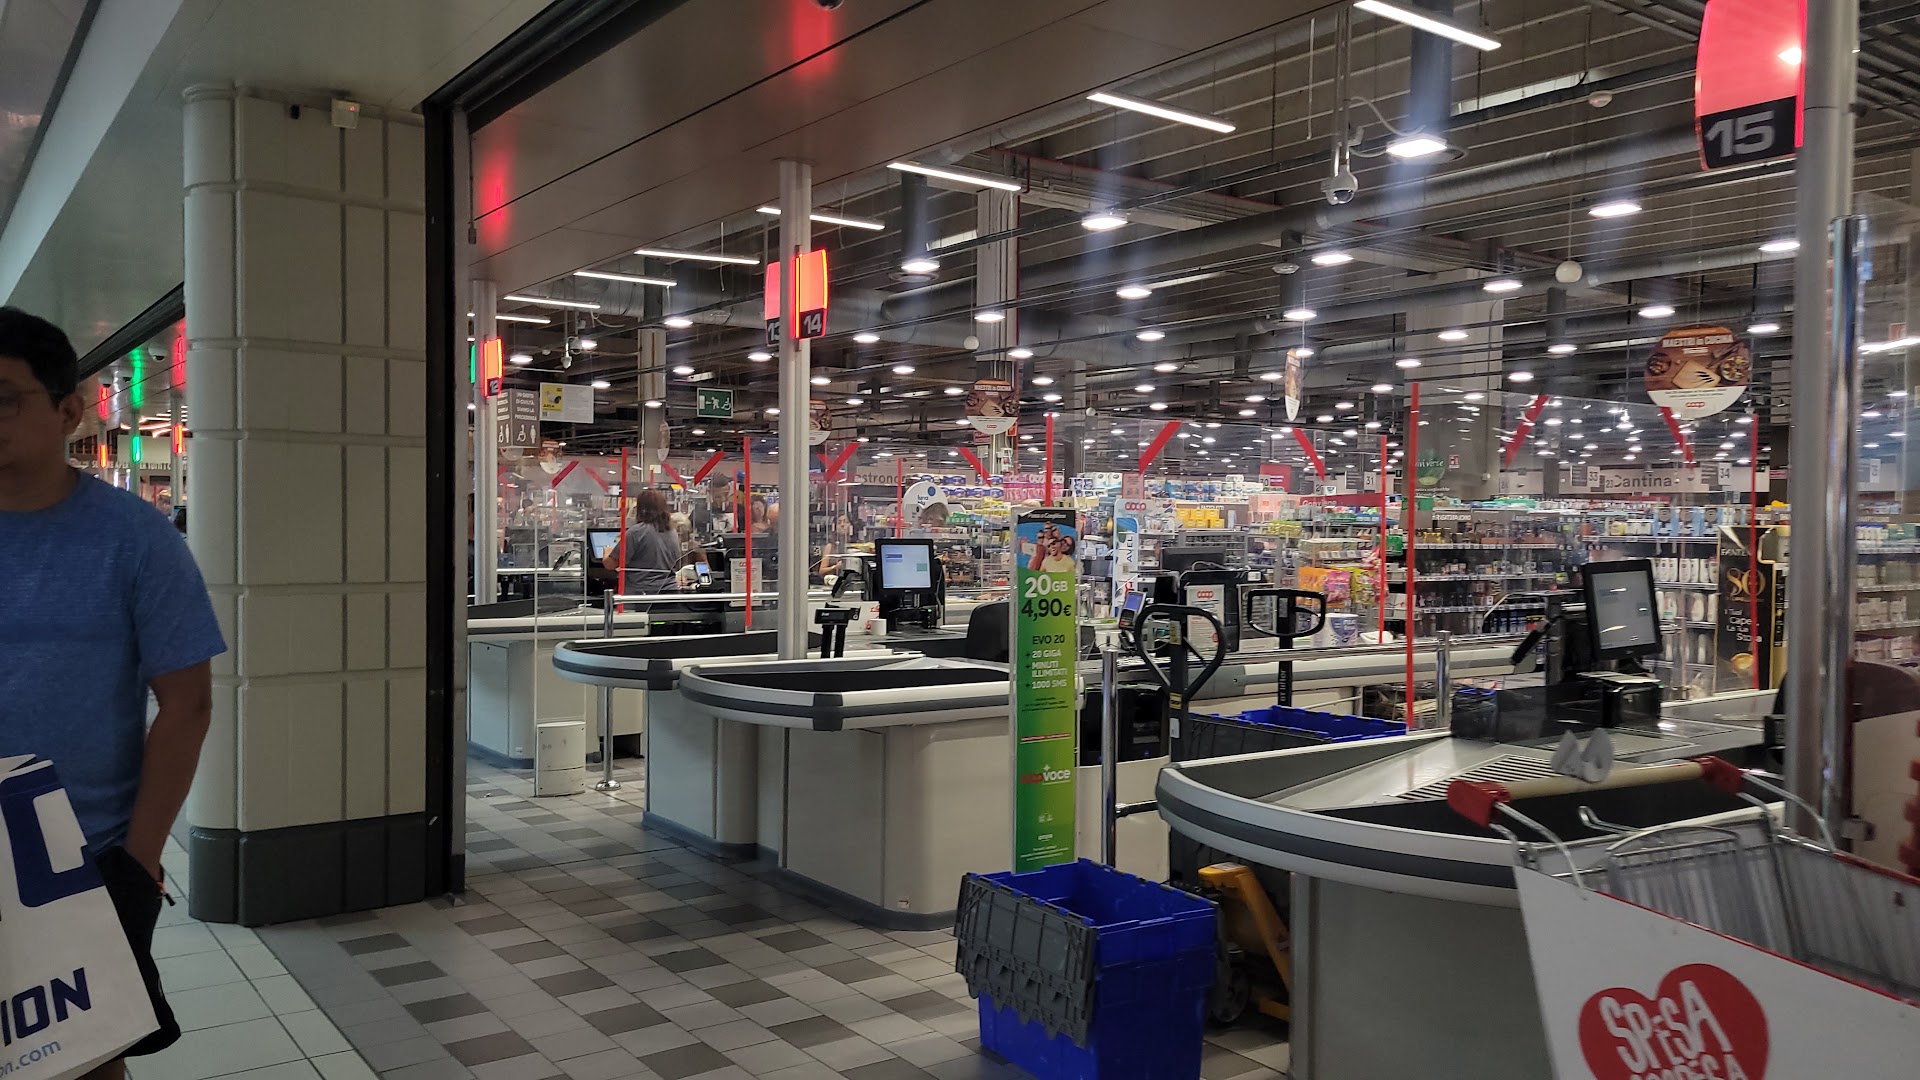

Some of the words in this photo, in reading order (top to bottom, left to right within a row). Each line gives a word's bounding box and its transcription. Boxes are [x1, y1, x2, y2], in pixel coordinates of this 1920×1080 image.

[1705, 110, 1775, 158] 15
[803, 313, 822, 335] 14
[1588, 471, 1598, 482] 33
[1719, 467, 1730, 479] 34
[1366, 475, 1374, 486] 31
[1033, 636, 1051, 645] EVO
[1054, 635, 1065, 644] 20
[1032, 660, 1059, 670] MINUTI
[1043, 769, 1071, 782] voce
[1600, 979, 1733, 1074] SPESA
